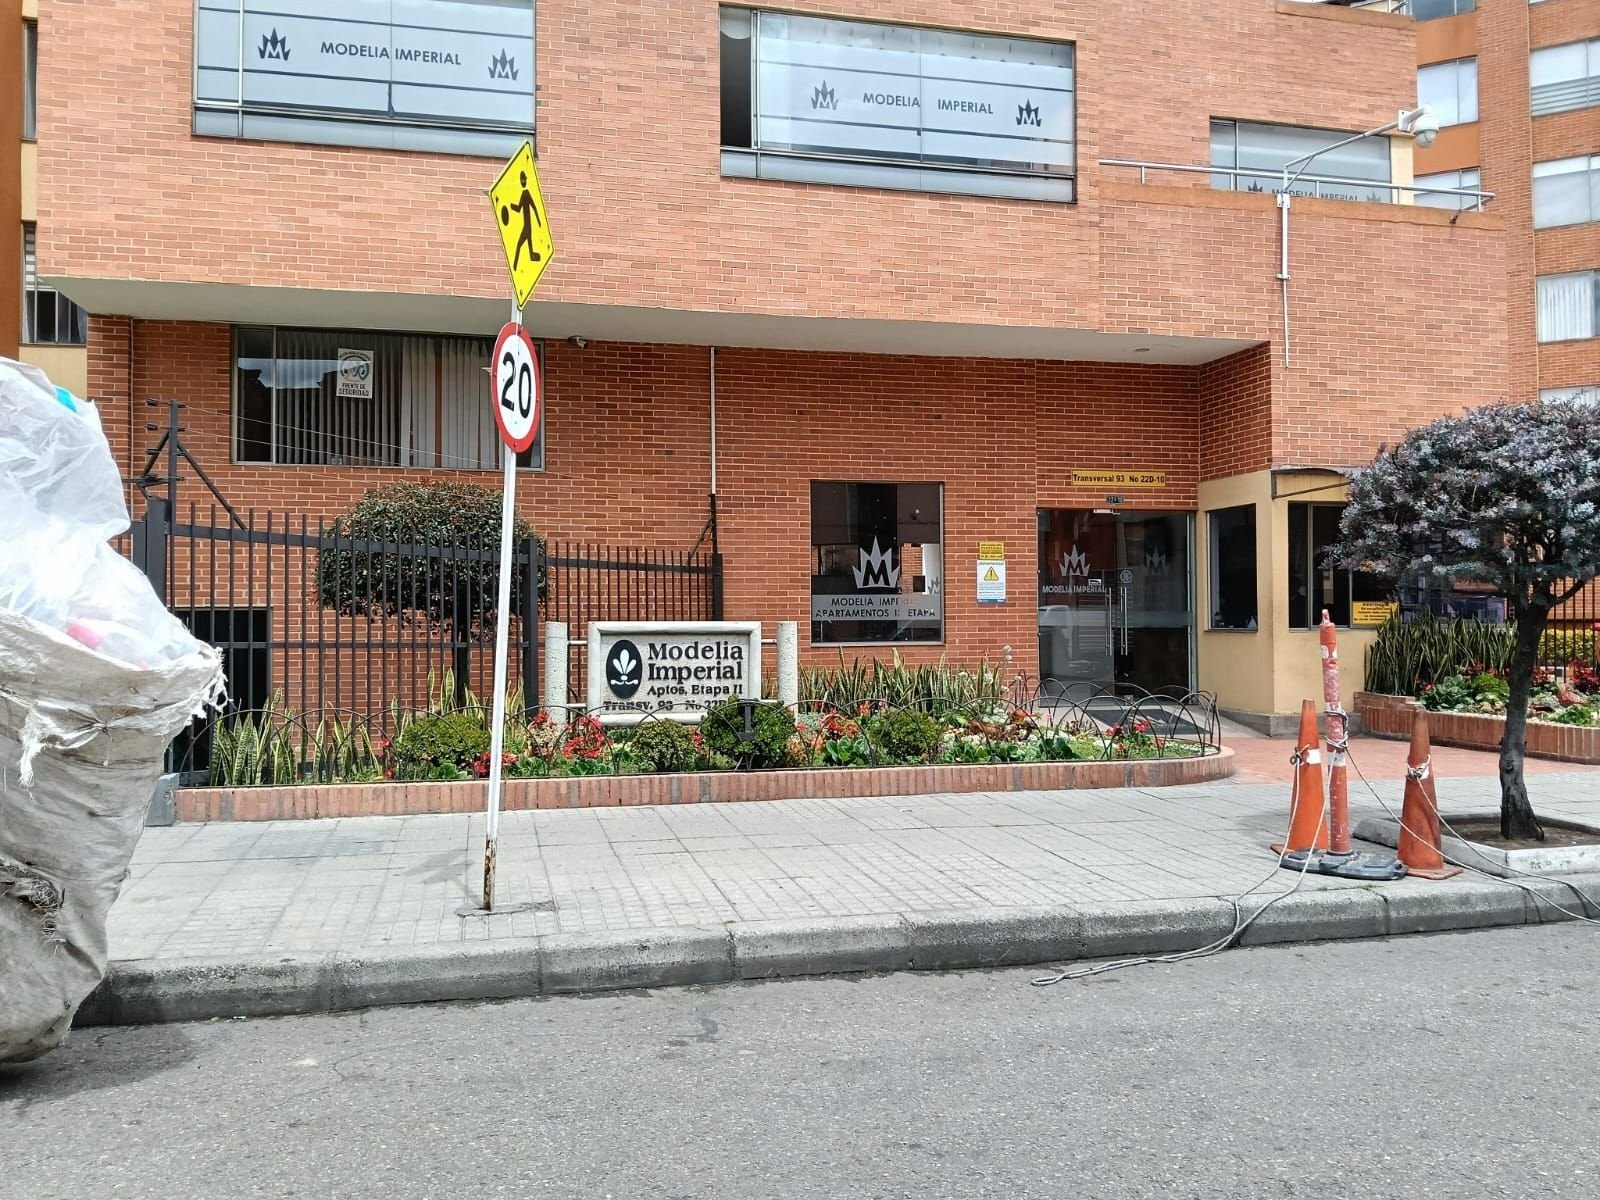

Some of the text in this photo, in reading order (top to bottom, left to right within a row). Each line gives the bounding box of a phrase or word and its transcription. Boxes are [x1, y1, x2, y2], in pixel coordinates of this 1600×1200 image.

[320, 41, 462, 66] MODELIA IMPERIAL
[862, 92, 994, 115] MODELIA IMPERIAL
[501, 351, 532, 419] 20
[1073, 474, 1165, 484] Transversal 93 No 22D-10
[1042, 585, 1072, 593] MODELIA
[831, 597, 874, 607] MODELIA
[816, 609, 889, 617] APARTAMENTOS
[907, 608, 936, 617] ETAPA
[647, 640, 744, 660] Modelia
[647, 660, 743, 684] Imperial
[691, 684, 730, 698] Etapa
[602, 700, 653, 711] Transv.
[657, 700, 674, 711] 93
